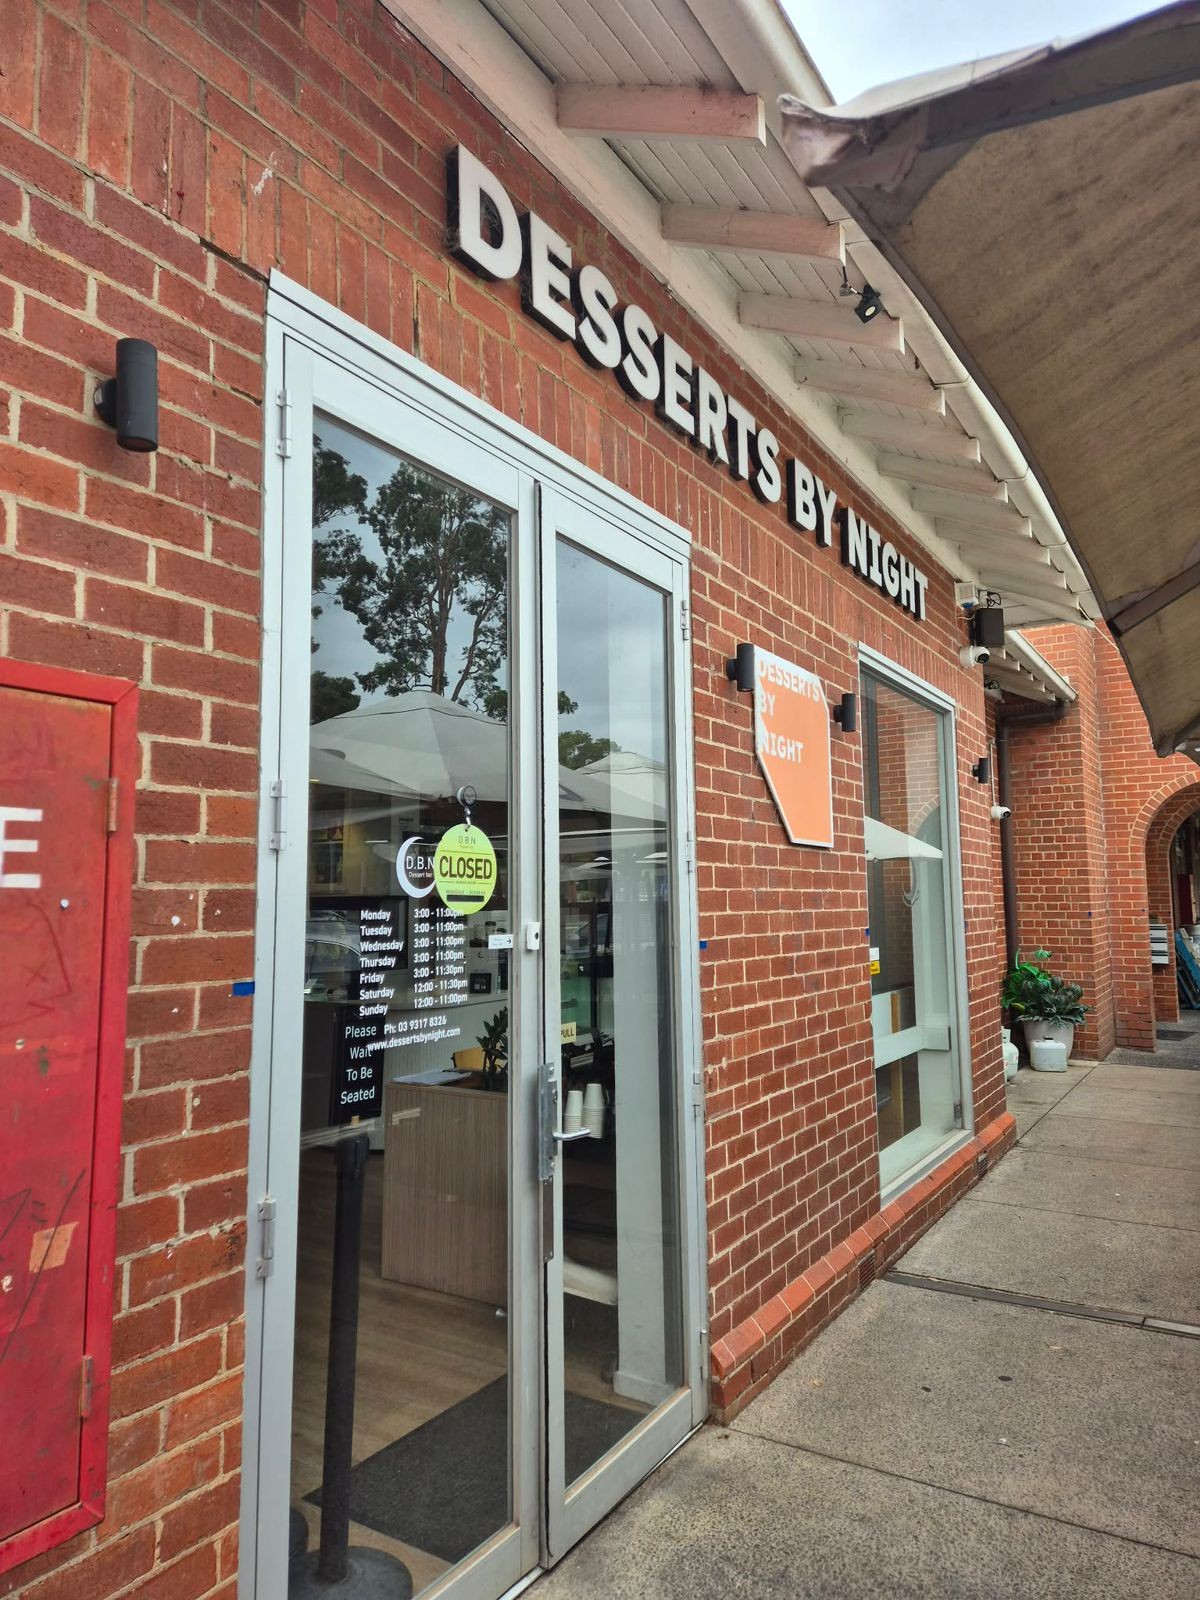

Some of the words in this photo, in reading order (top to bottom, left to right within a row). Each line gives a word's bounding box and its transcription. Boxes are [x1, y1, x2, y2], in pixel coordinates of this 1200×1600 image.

[452, 144, 782, 504] DESSERTS
[791, 458, 839, 548] BY
[844, 506, 928, 622] NIGHT
[757, 659, 820, 703] DESSERTS
[759, 691, 776, 717] BY
[759, 729, 804, 764] NIGHT
[440, 855, 493, 880] CLOSED
[360, 910, 391, 921] Monday
[414, 908, 430, 919] 3:00
[436, 908, 464, 920] 11:00pm
[360, 925, 392, 937] Tuesday
[414, 923, 430, 933] 3:00
[436, 922, 464, 933] 11:00pm
[360, 941, 404, 952] Wednesday
[414, 938, 430, 948] 3:00
[436, 936, 464, 948] 11:00pm
[360, 956, 396, 968] Thursday
[414, 953, 430, 963] 3:00
[436, 951, 464, 962] 11:00pm
[360, 972, 385, 984] Friday
[414, 968, 430, 978] 3:00
[436, 965, 464, 976] 11:30pm
[360, 988, 394, 1000] Saturday
[414, 982, 434, 993] 12:00
[440, 979, 468, 990] 11:30pm
[359, 1004, 388, 1017] Sunday
[414, 997, 434, 1009] 12:00
[440, 994, 468, 1005] 11:00pm
[345, 1026, 377, 1039] Please
[384, 1023, 397, 1035] Ph:
[398, 1022, 408, 1032] 03
[409, 1018, 427, 1030] 9317
[429, 1015, 447, 1027] 8326
[366, 1027, 461, 1052] www.dessertsbynight.com
[350, 1047, 372, 1059] Wait
[346, 1069, 358, 1081] To
[360, 1067, 373, 1080] Be
[340, 1086, 375, 1105] Seated
